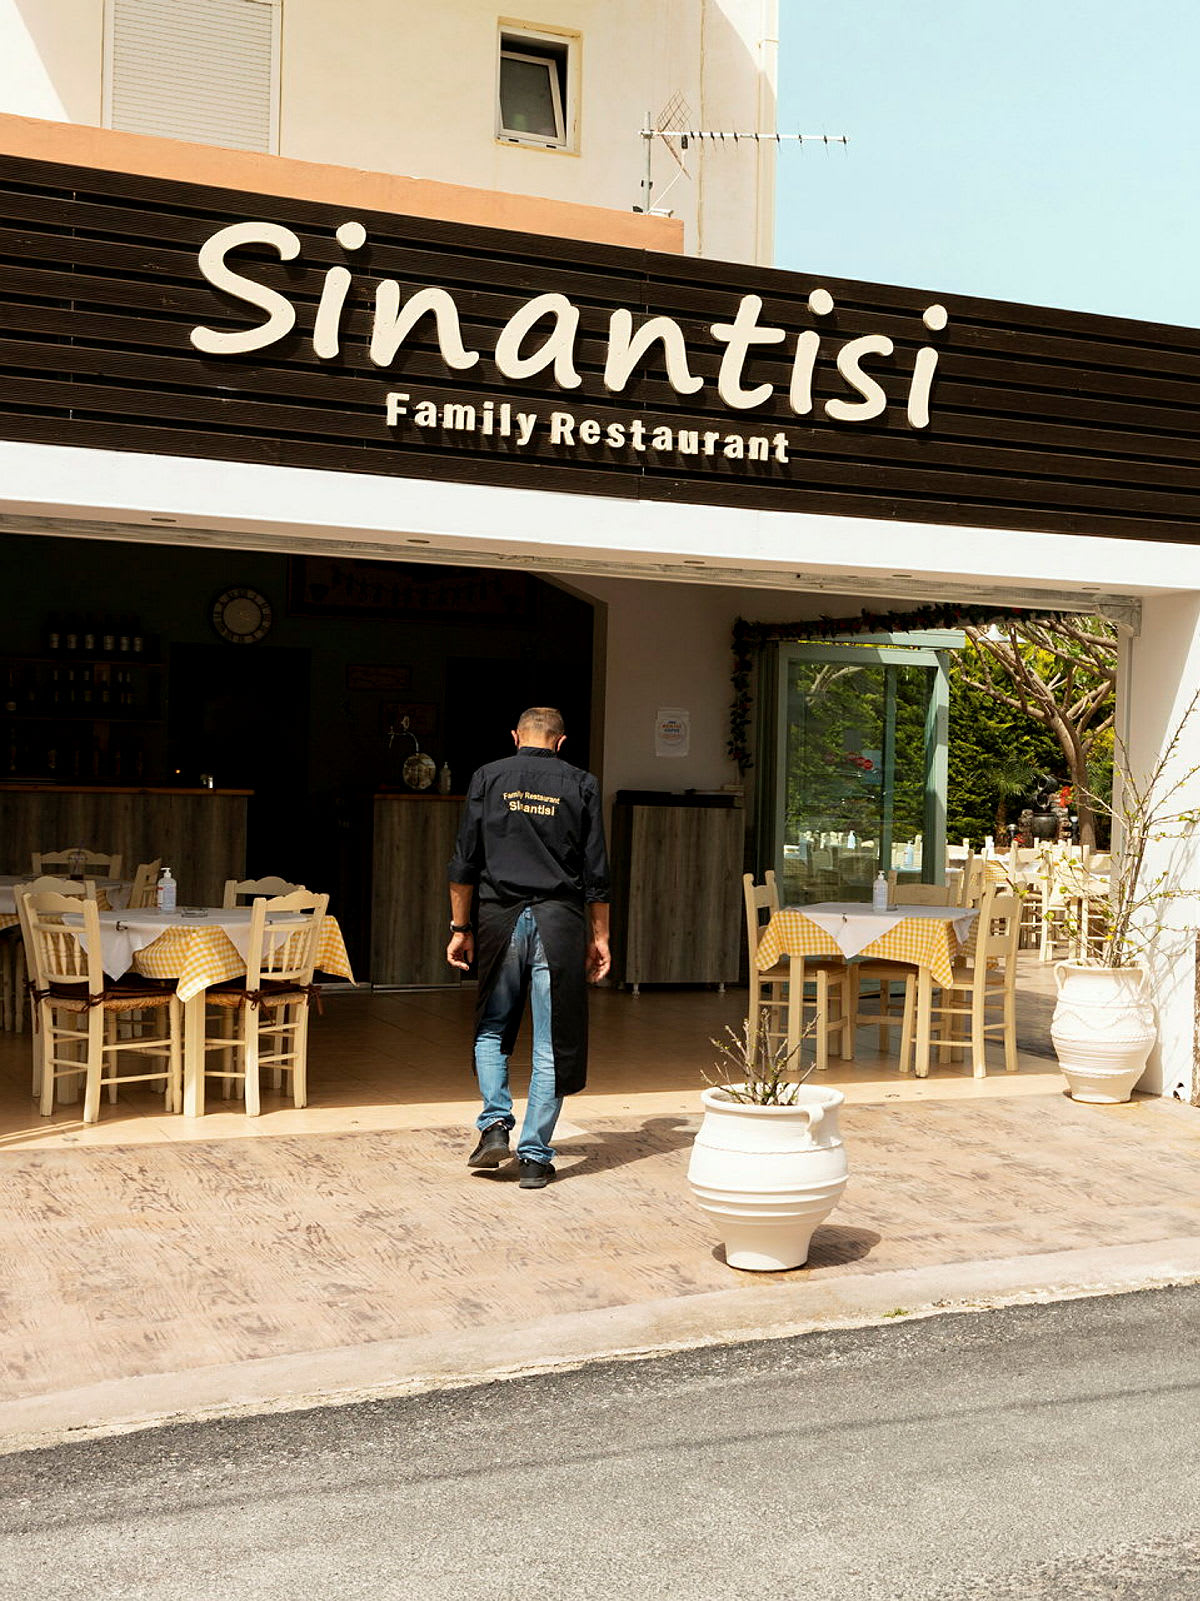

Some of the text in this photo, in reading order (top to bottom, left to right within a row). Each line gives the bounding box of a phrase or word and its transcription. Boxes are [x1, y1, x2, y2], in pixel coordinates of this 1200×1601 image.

[190, 221, 948, 429] Sinantisi
[386, 391, 789, 464] Family Restaurant
[503, 790, 560, 804] Family Restaurant
